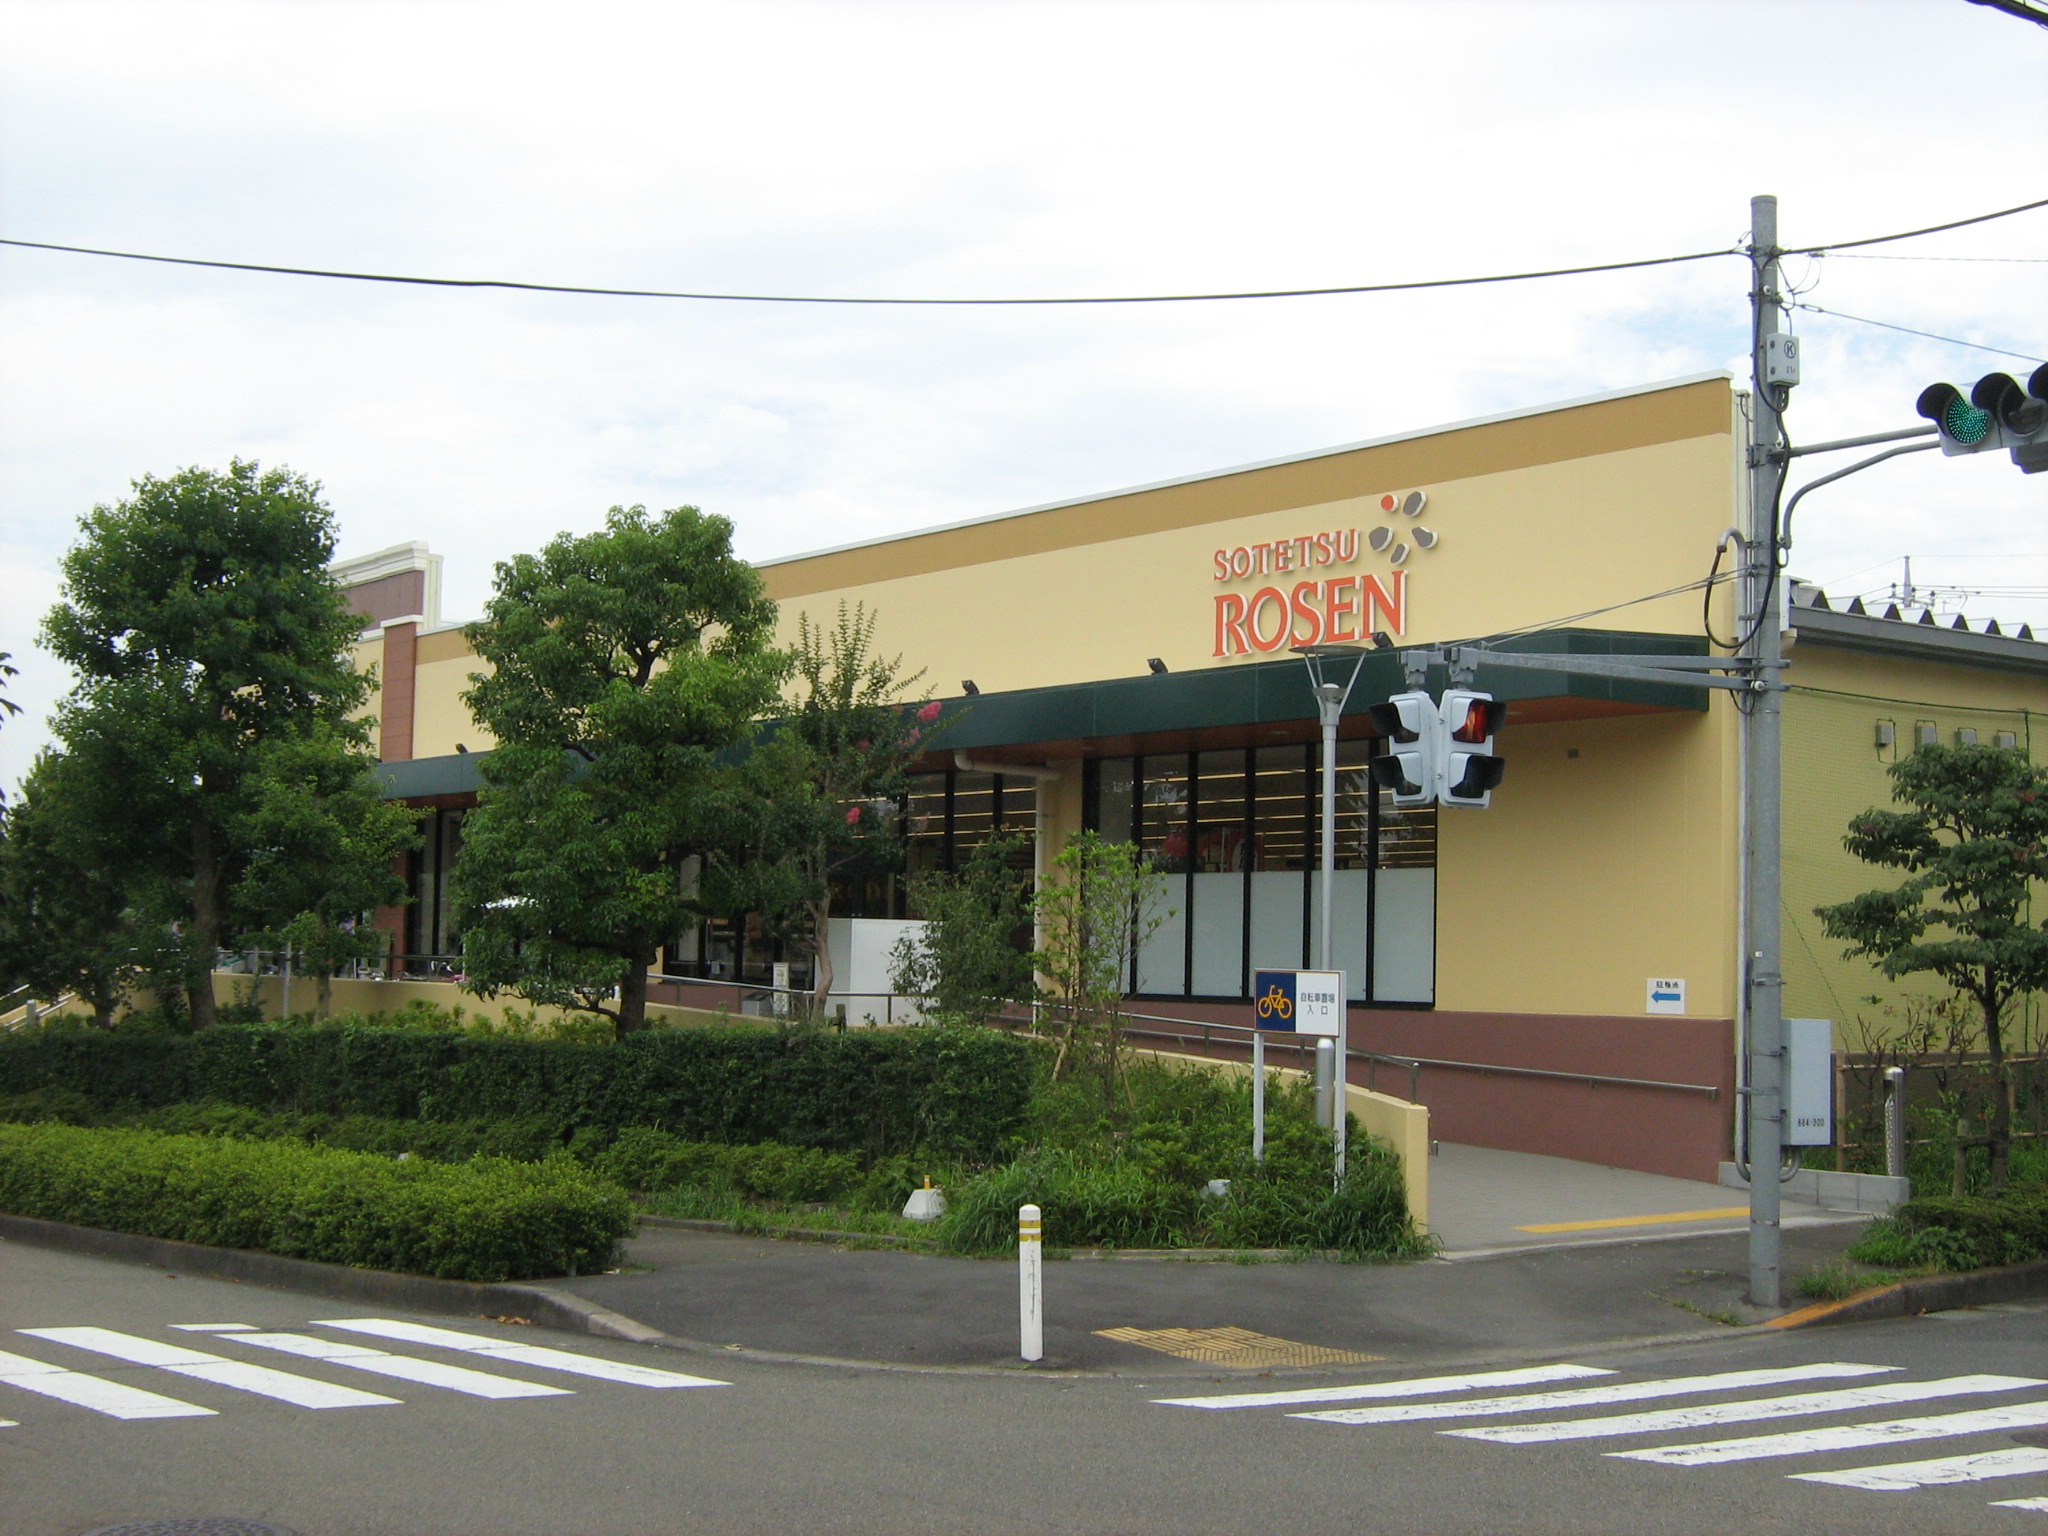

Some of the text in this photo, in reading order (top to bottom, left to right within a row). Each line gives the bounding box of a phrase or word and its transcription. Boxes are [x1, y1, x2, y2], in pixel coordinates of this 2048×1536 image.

[1213, 528, 1360, 582] SOTETSU
[1212, 570, 1408, 658] ROSEN
[1300, 993, 1335, 1003] 自転車置場
